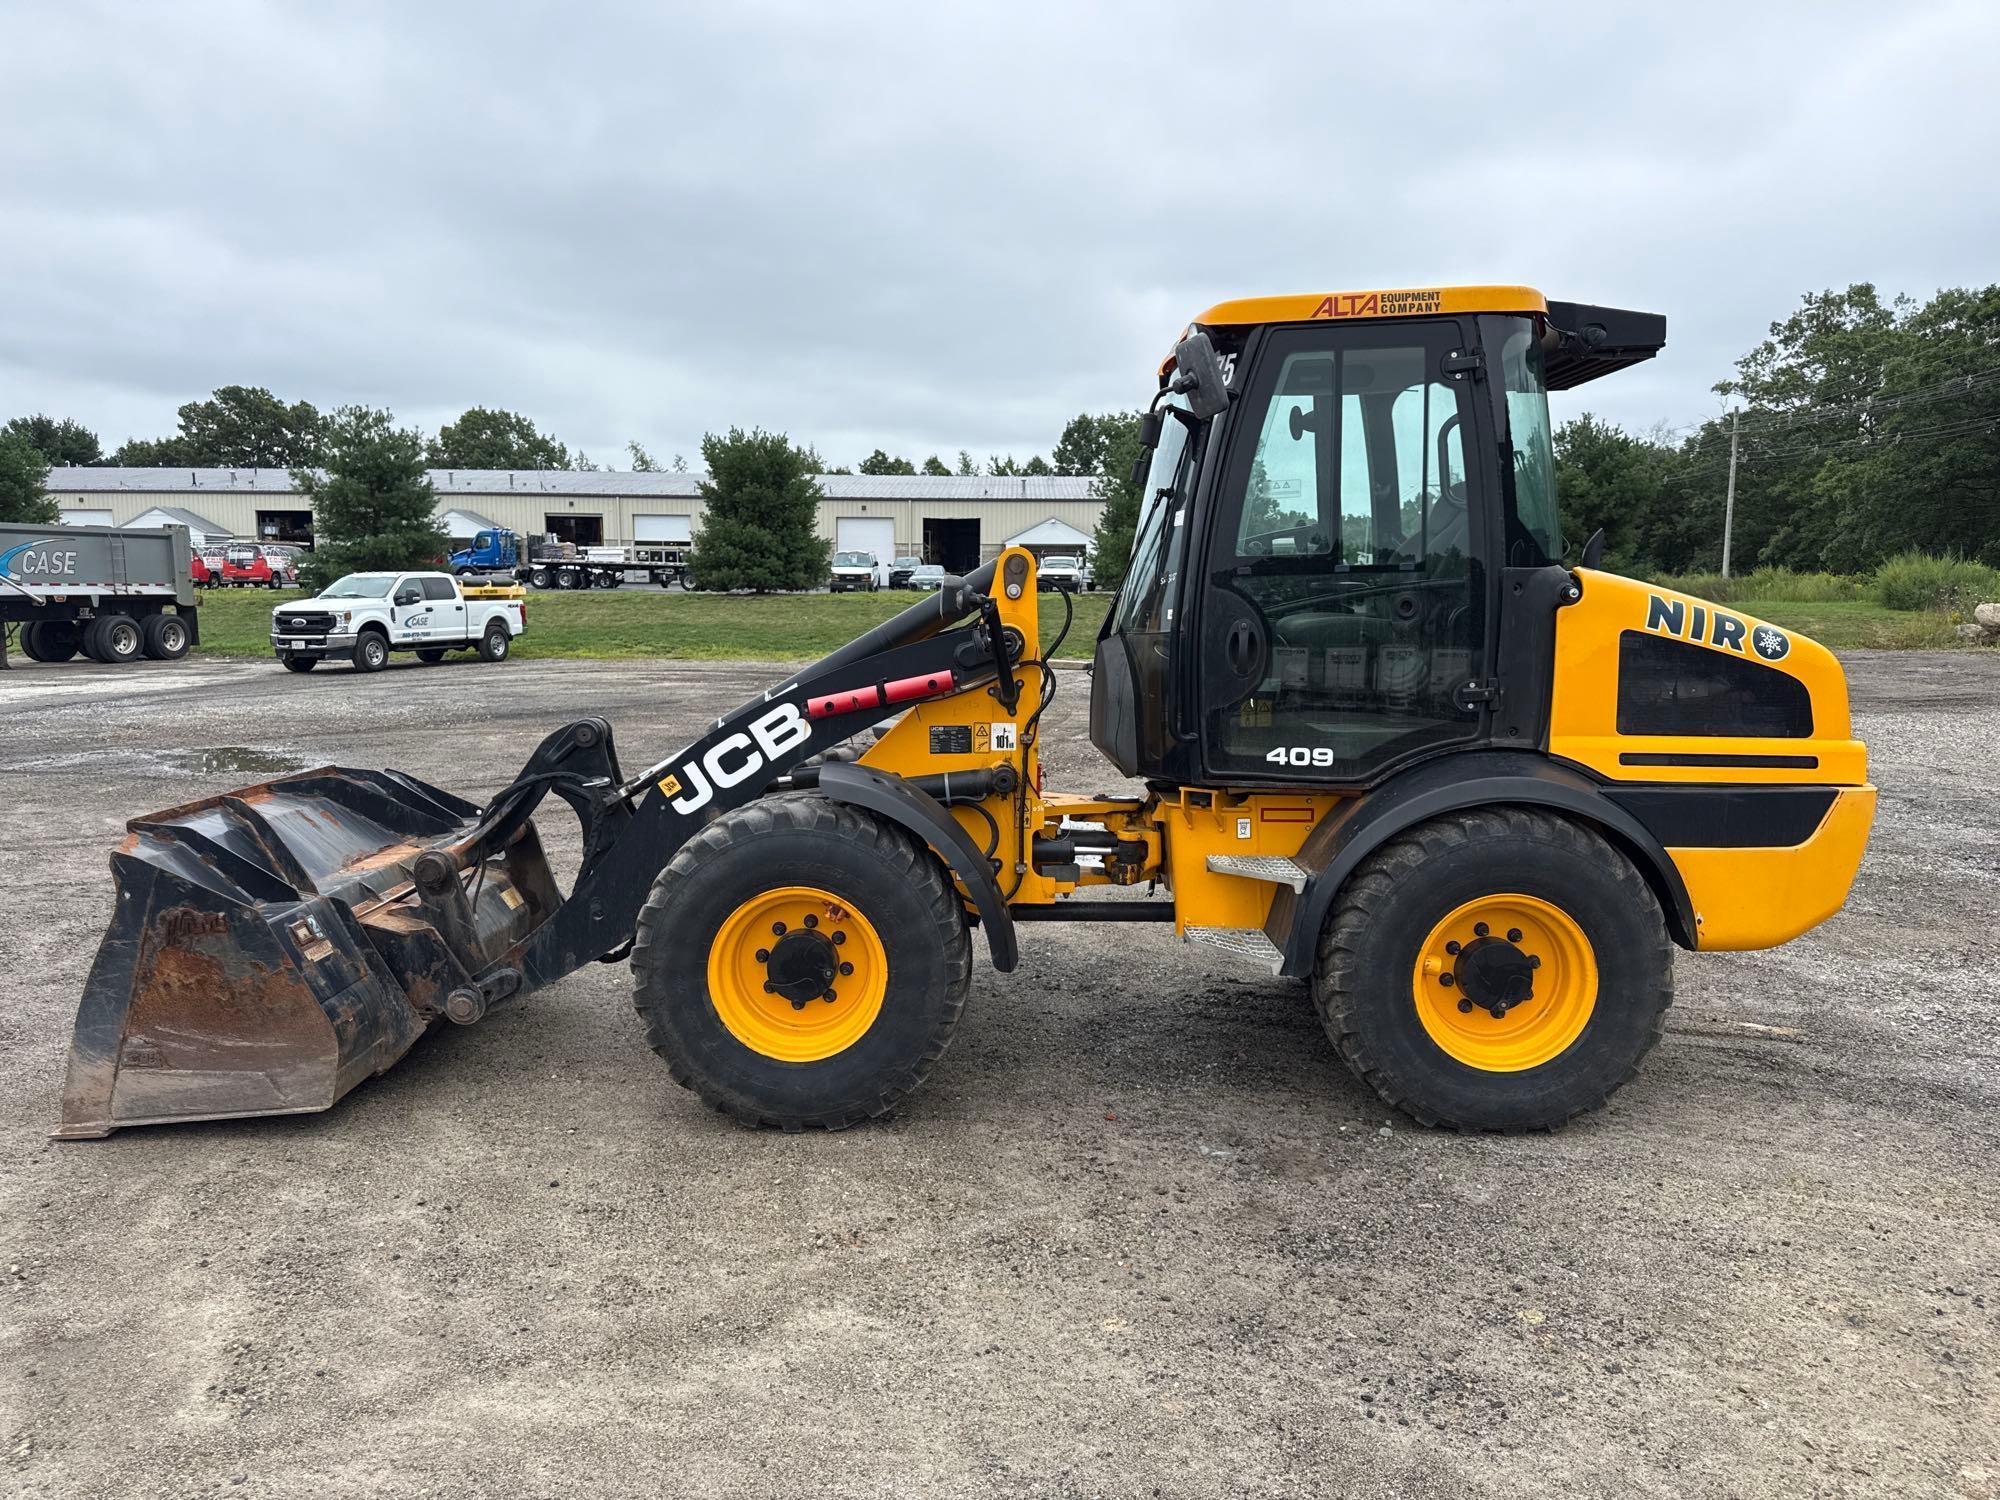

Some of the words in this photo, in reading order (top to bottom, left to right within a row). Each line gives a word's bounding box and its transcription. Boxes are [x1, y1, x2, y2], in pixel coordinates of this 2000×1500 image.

[1310, 294, 1378, 318] ALTA
[1380, 291, 1441, 303] EQUIPMENT
[1380, 302, 1441, 314] COMPANY
[22, 550, 77, 575] CASE
[411, 616, 429, 627] CASE
[995, 735, 1009, 749] 101
[671, 702, 813, 816] JCB
[1265, 747, 1334, 767] 409
[661, 779, 678, 793] JCB
